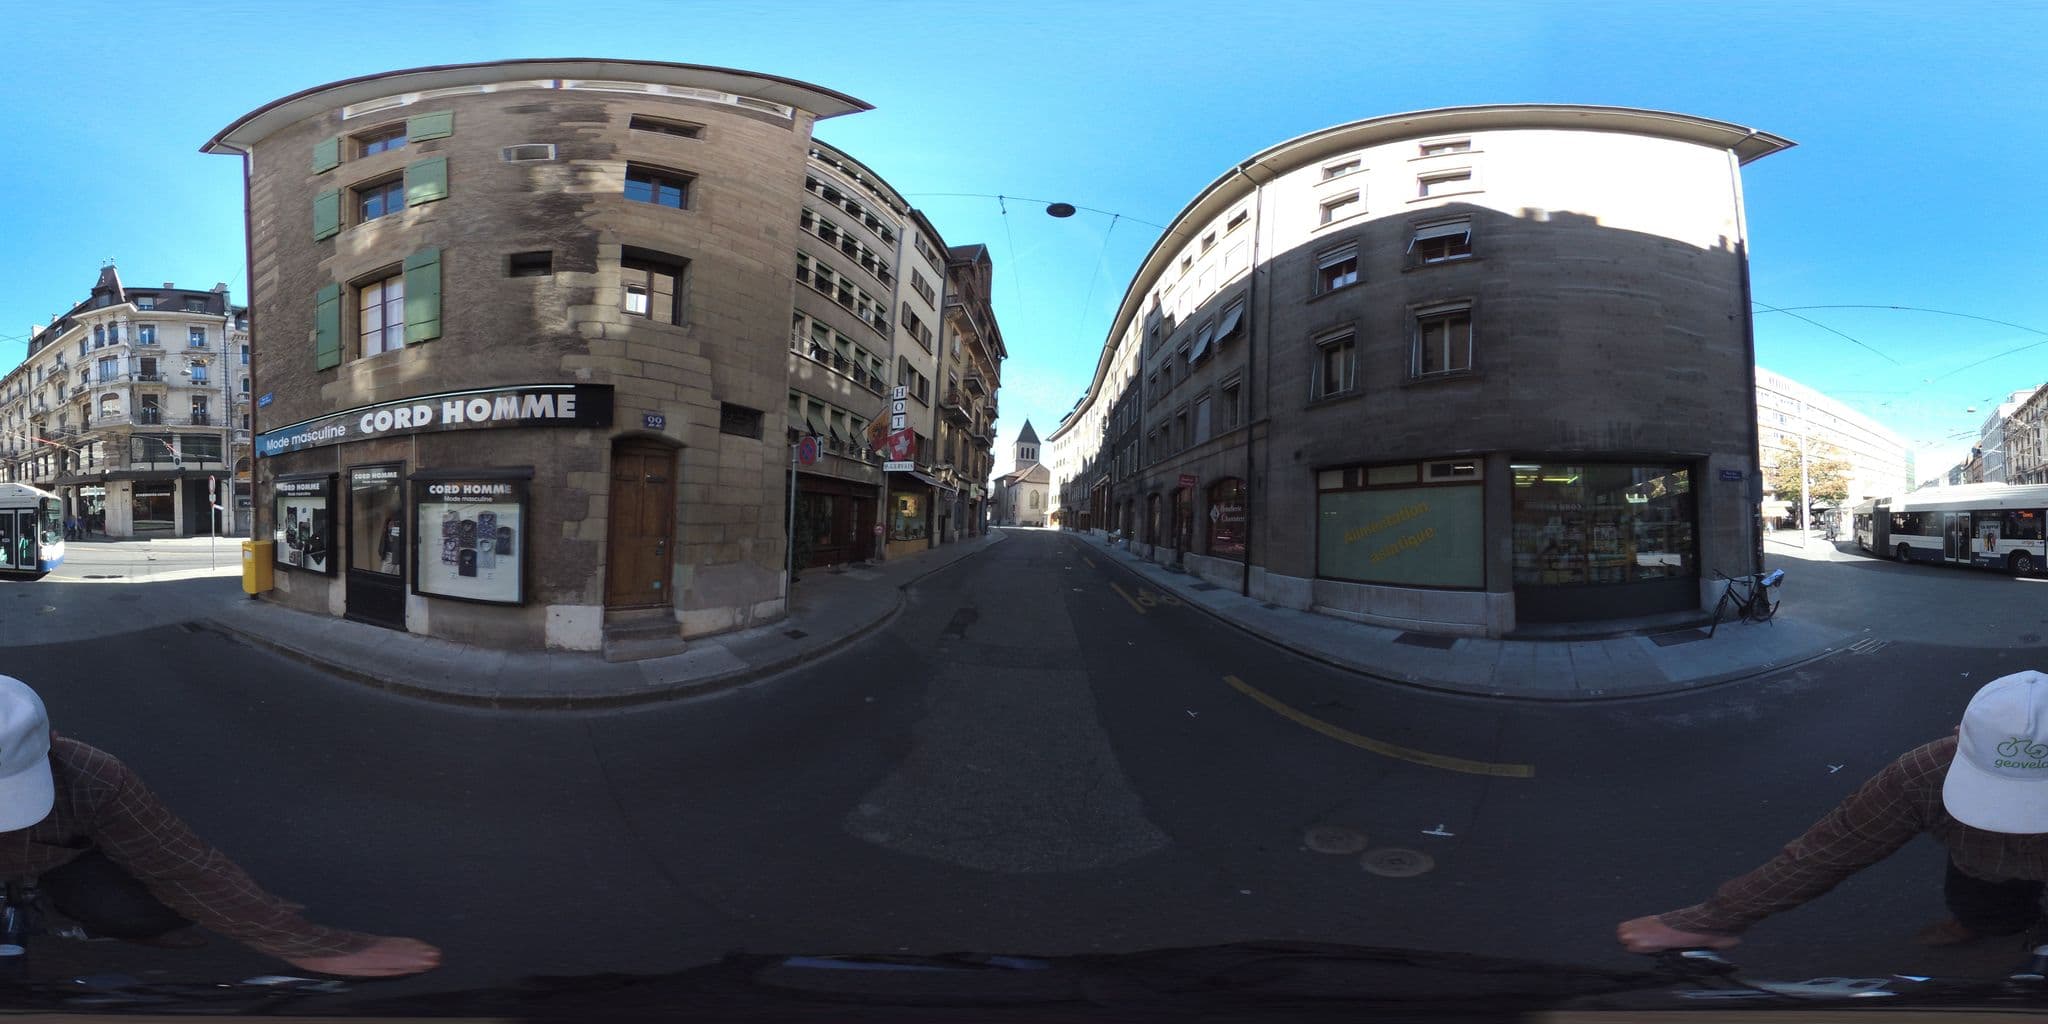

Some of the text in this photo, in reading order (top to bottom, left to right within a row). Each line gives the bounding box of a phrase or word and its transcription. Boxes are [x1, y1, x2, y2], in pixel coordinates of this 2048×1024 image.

[266, 394, 576, 450] Mode masculine CORD HOMME
[647, 415, 662, 427] 22
[371, 471, 398, 479] HOMME
[429, 484, 512, 494] CORD HOMME
[1994, 759, 2048, 768] geovelo
